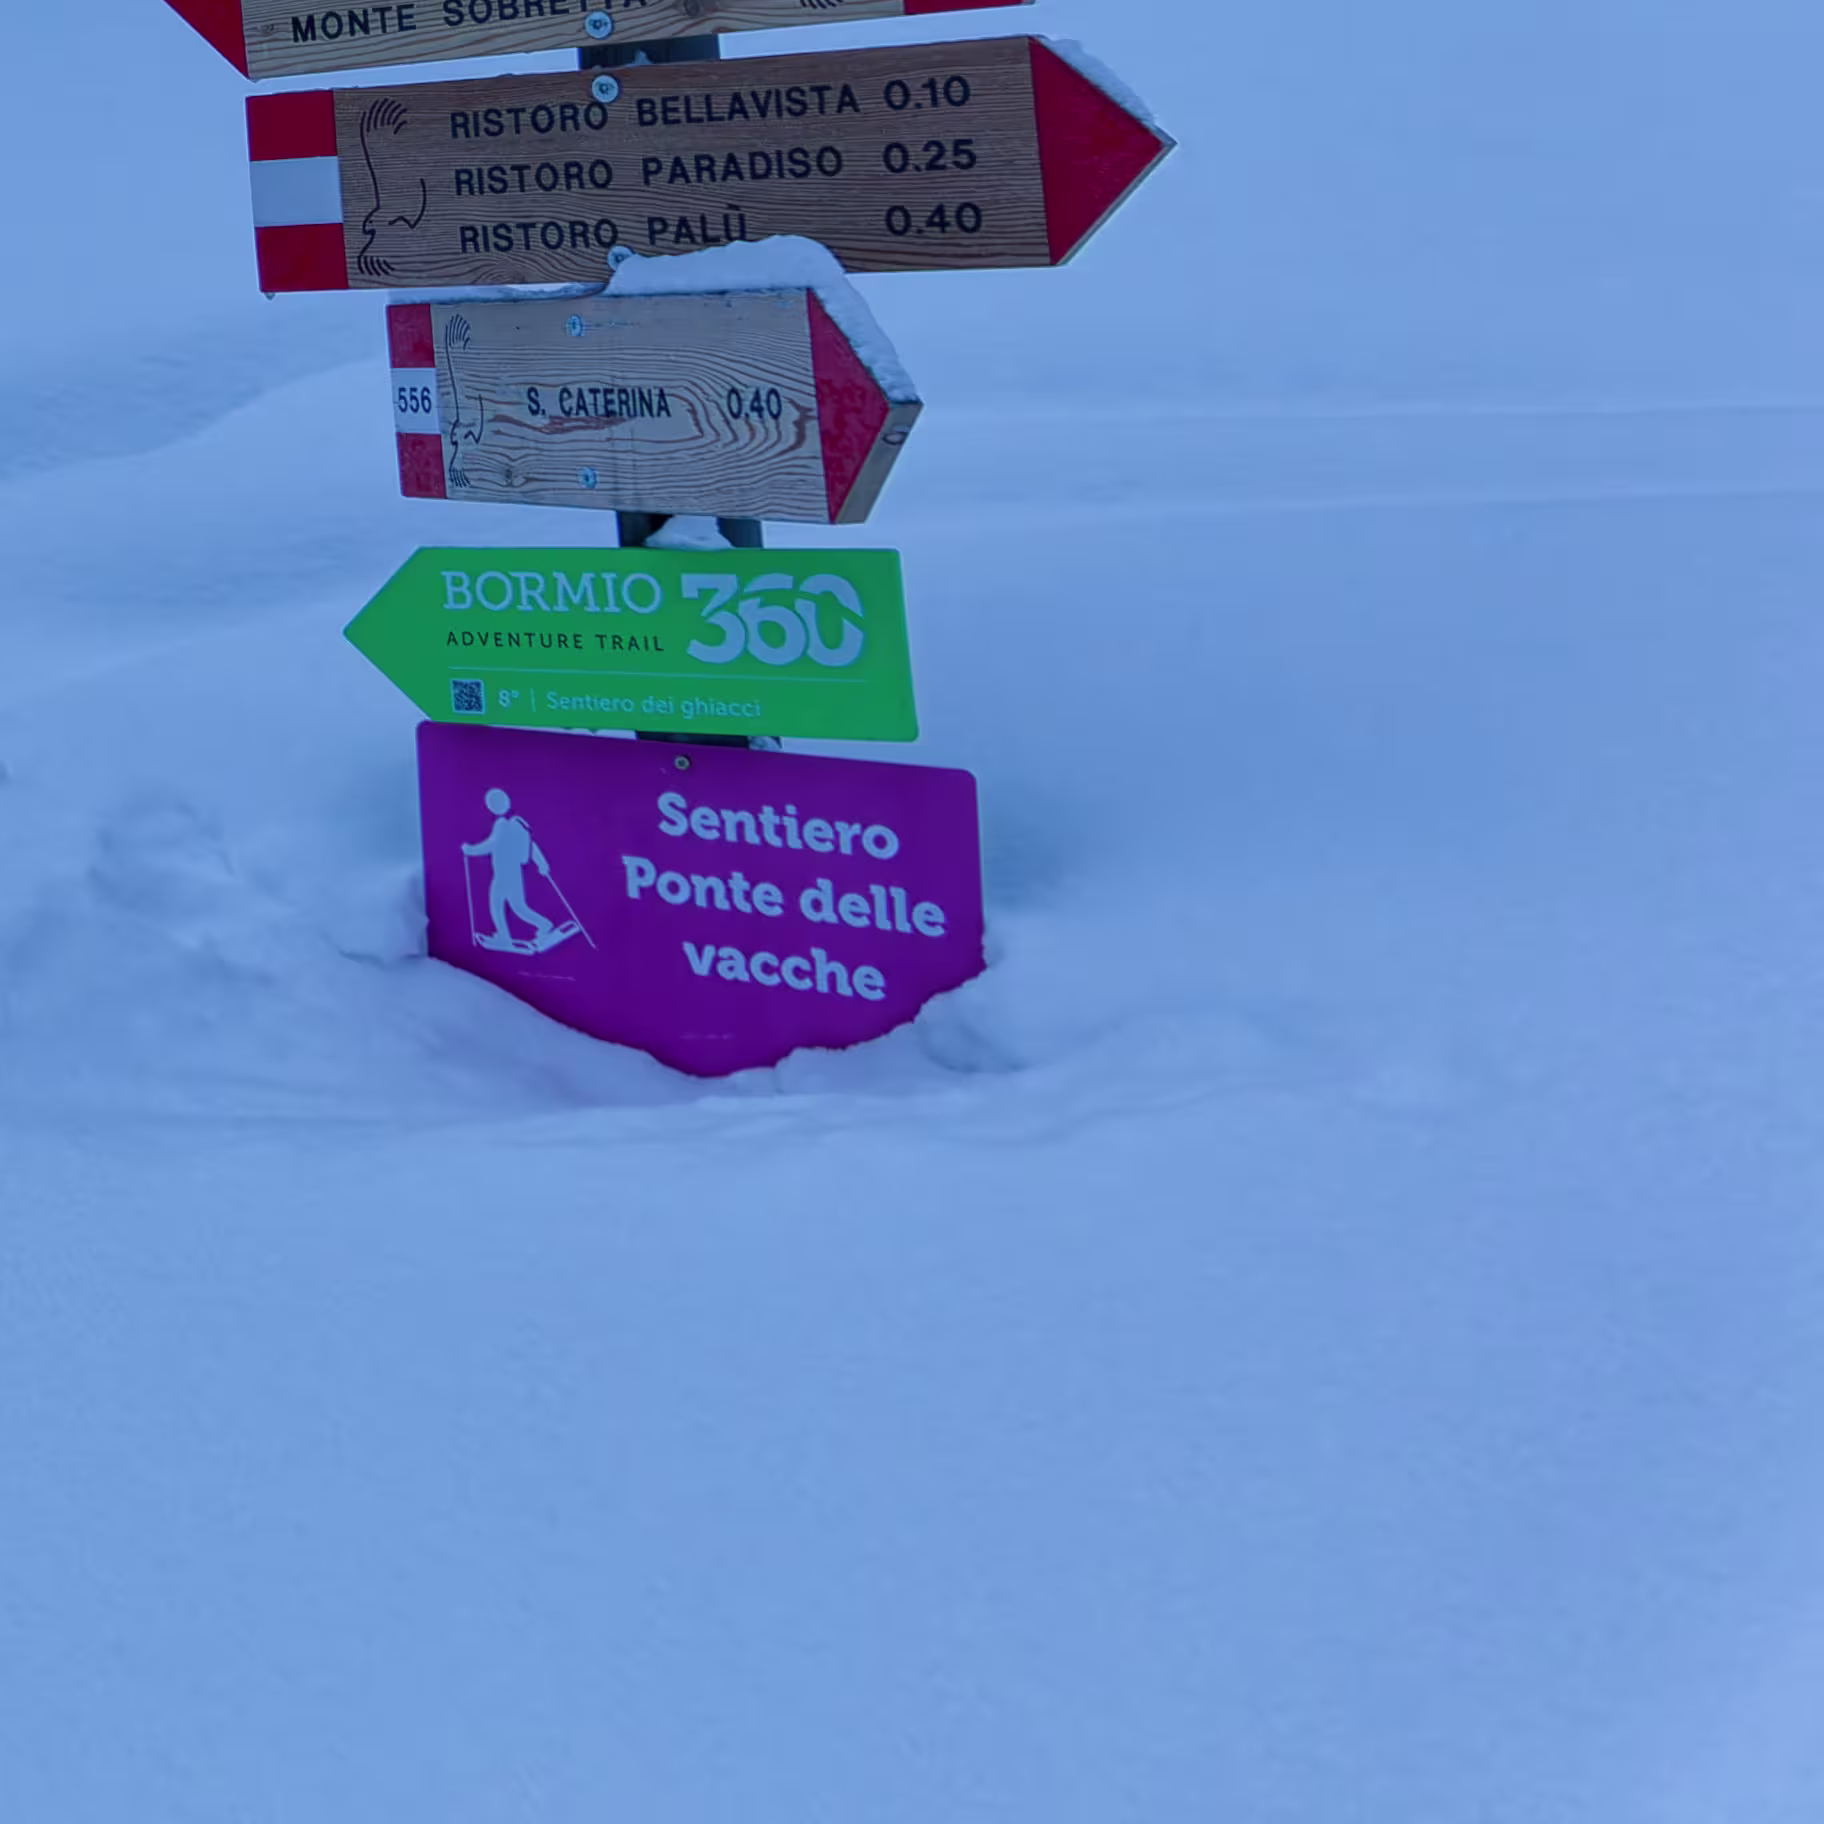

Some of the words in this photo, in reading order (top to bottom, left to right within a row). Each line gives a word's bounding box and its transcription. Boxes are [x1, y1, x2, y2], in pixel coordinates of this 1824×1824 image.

[291, 2, 418, 44] MONTE
[450, 100, 609, 140] RISTORO
[636, 84, 860, 129] BELLAVISTA
[884, 75, 971, 110] 0.10
[454, 159, 613, 197] RISTORO
[642, 147, 843, 187] PARADISO
[883, 140, 978, 174] 0.25
[459, 218, 618, 254] RISTORO
[648, 206, 748, 247] PALÙ
[885, 202, 982, 237] 0.40
[398, 386, 432, 414] 556
[527, 388, 546, 416] S.
[559, 387, 672, 419] CATERINA
[727, 388, 782, 420] 0.40
[441, 572, 663, 614] BORMIO
[681, 573, 865, 667] 360
[446, 631, 583, 650] ADVENTURE
[596, 634, 664, 652] TRAIL
[547, 692, 634, 713] Sentiero
[641, 694, 675, 716] dei
[680, 697, 761, 721] ghiacci
[657, 792, 899, 860] Sentiero
[622, 855, 783, 917] Ponte
[799, 878, 945, 937] delle
[683, 941, 886, 1000] vacche
